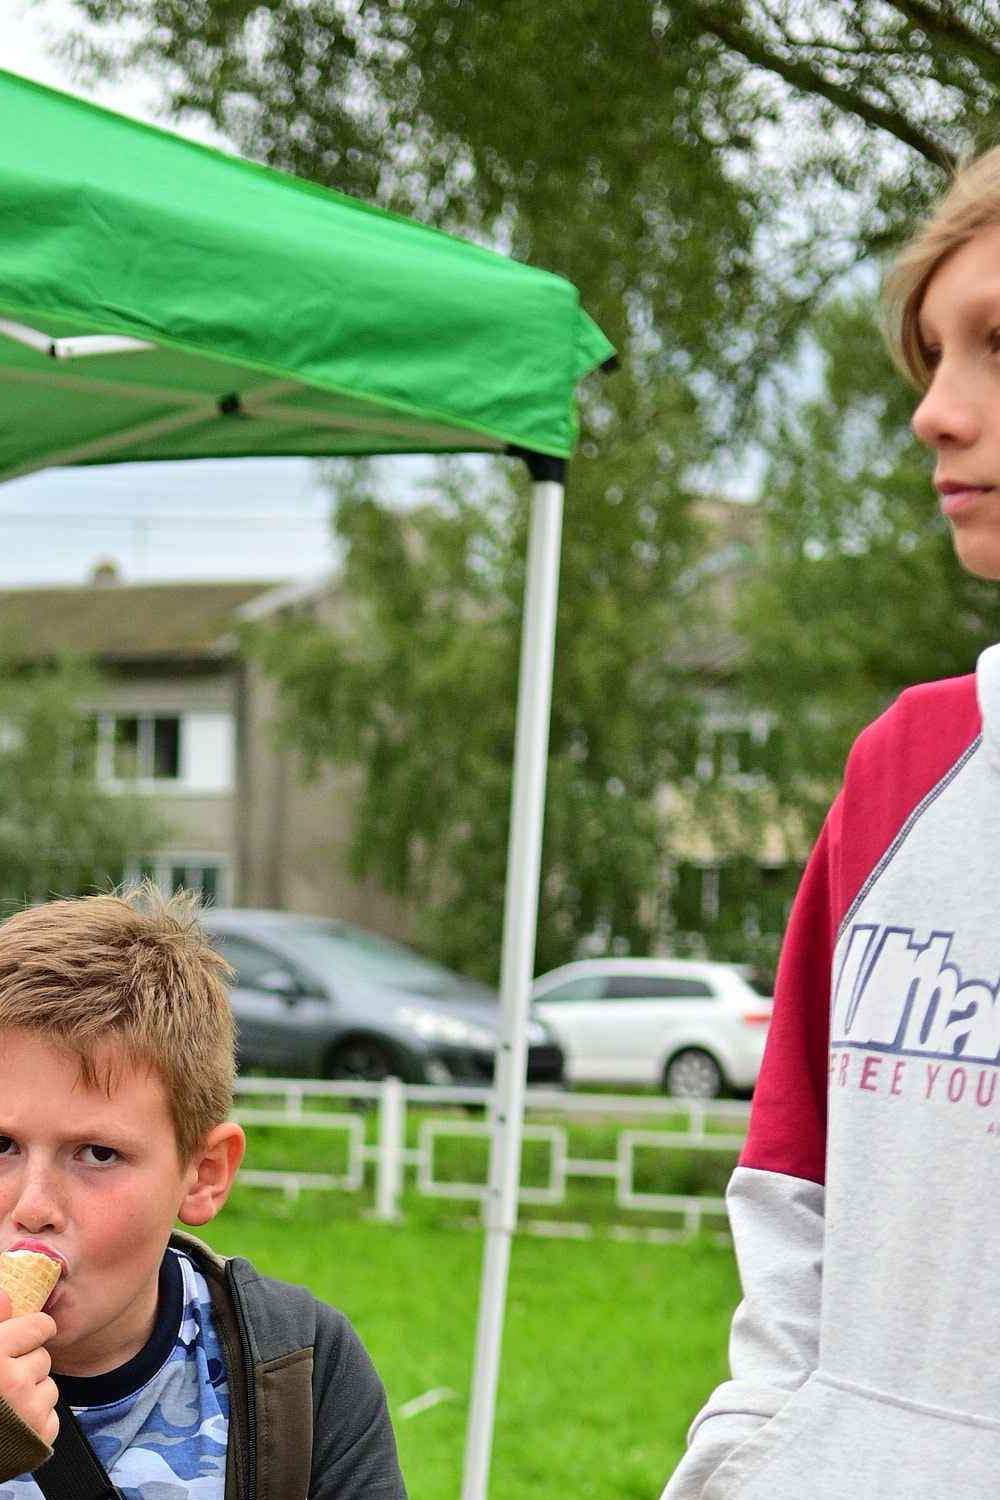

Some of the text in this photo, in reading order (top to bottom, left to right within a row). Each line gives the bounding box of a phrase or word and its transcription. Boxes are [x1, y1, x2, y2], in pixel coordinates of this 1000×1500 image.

[829, 924, 1000, 1066] Urba
[829, 1052, 998, 1108] FREE YOU
